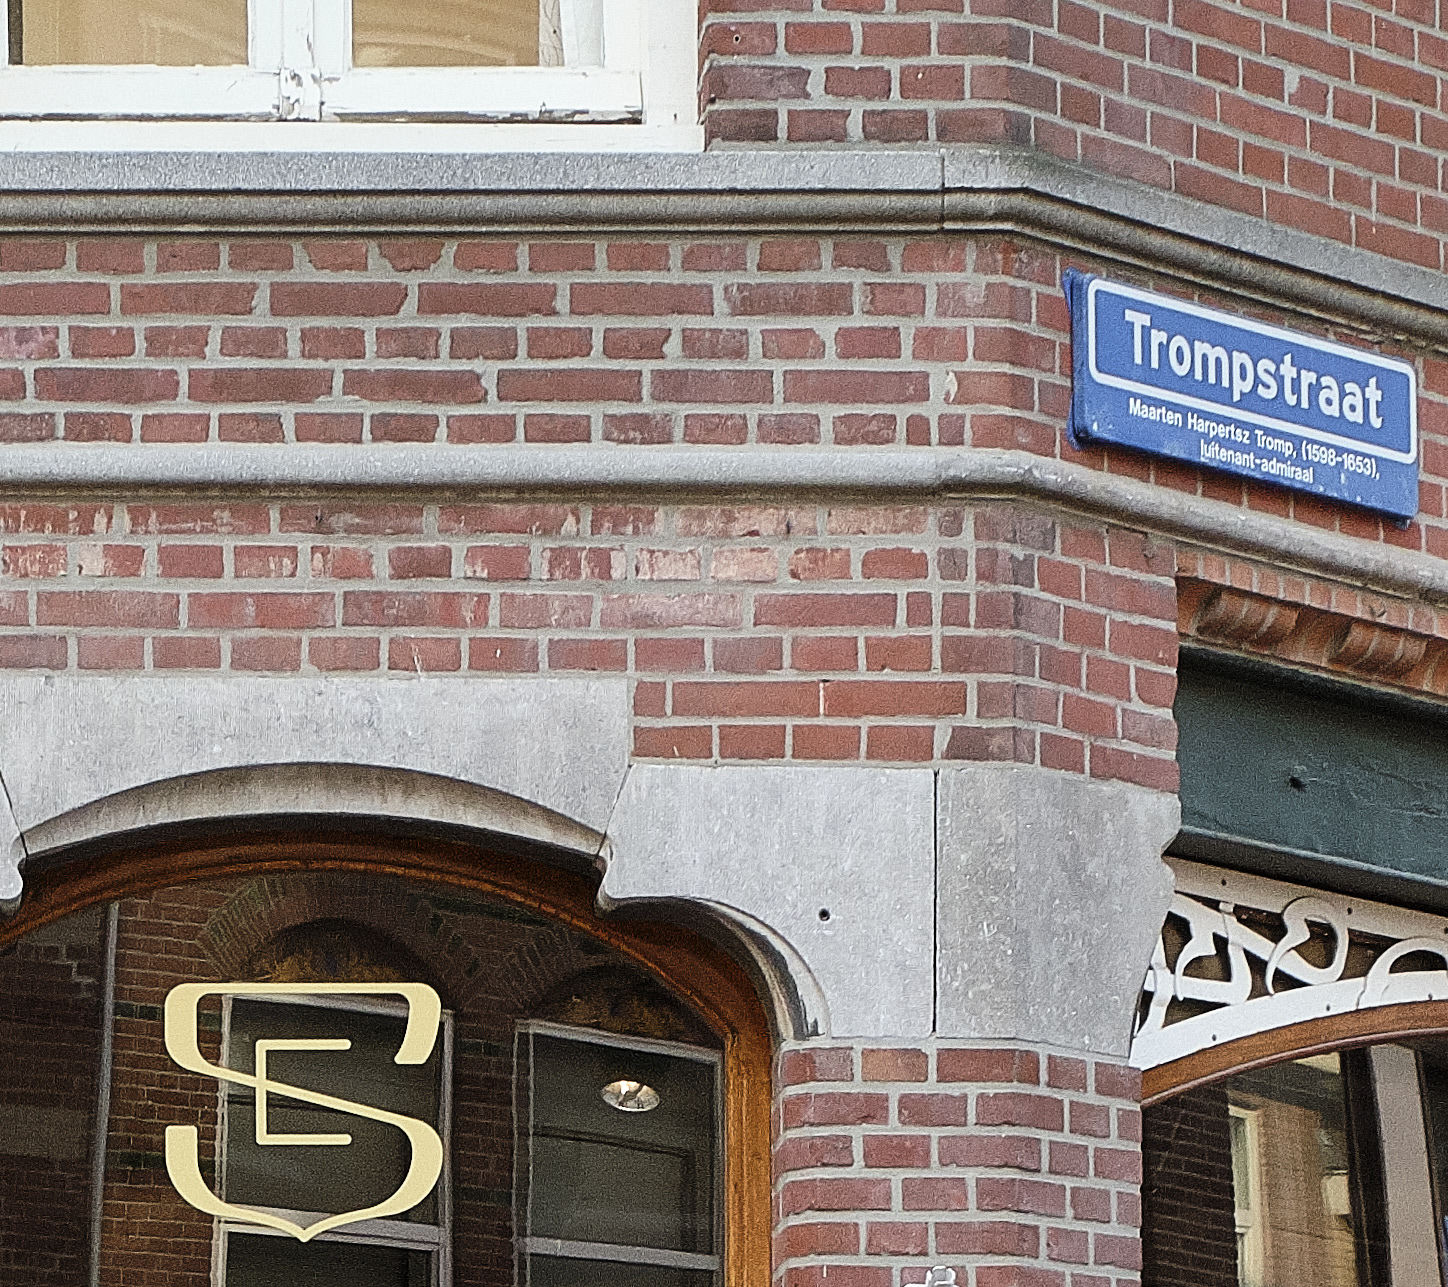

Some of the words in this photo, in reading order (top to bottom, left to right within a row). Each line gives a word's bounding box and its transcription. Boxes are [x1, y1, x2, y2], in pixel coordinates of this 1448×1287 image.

[1125, 309, 1384, 429] Trompstraat
[1129, 398, 1183, 427] Maarten
[1187, 411, 1251, 443] Harpertsz
[1254, 430, 1297, 459] Tromp,
[1200, 439, 1314, 484] luitenant-admiraal
